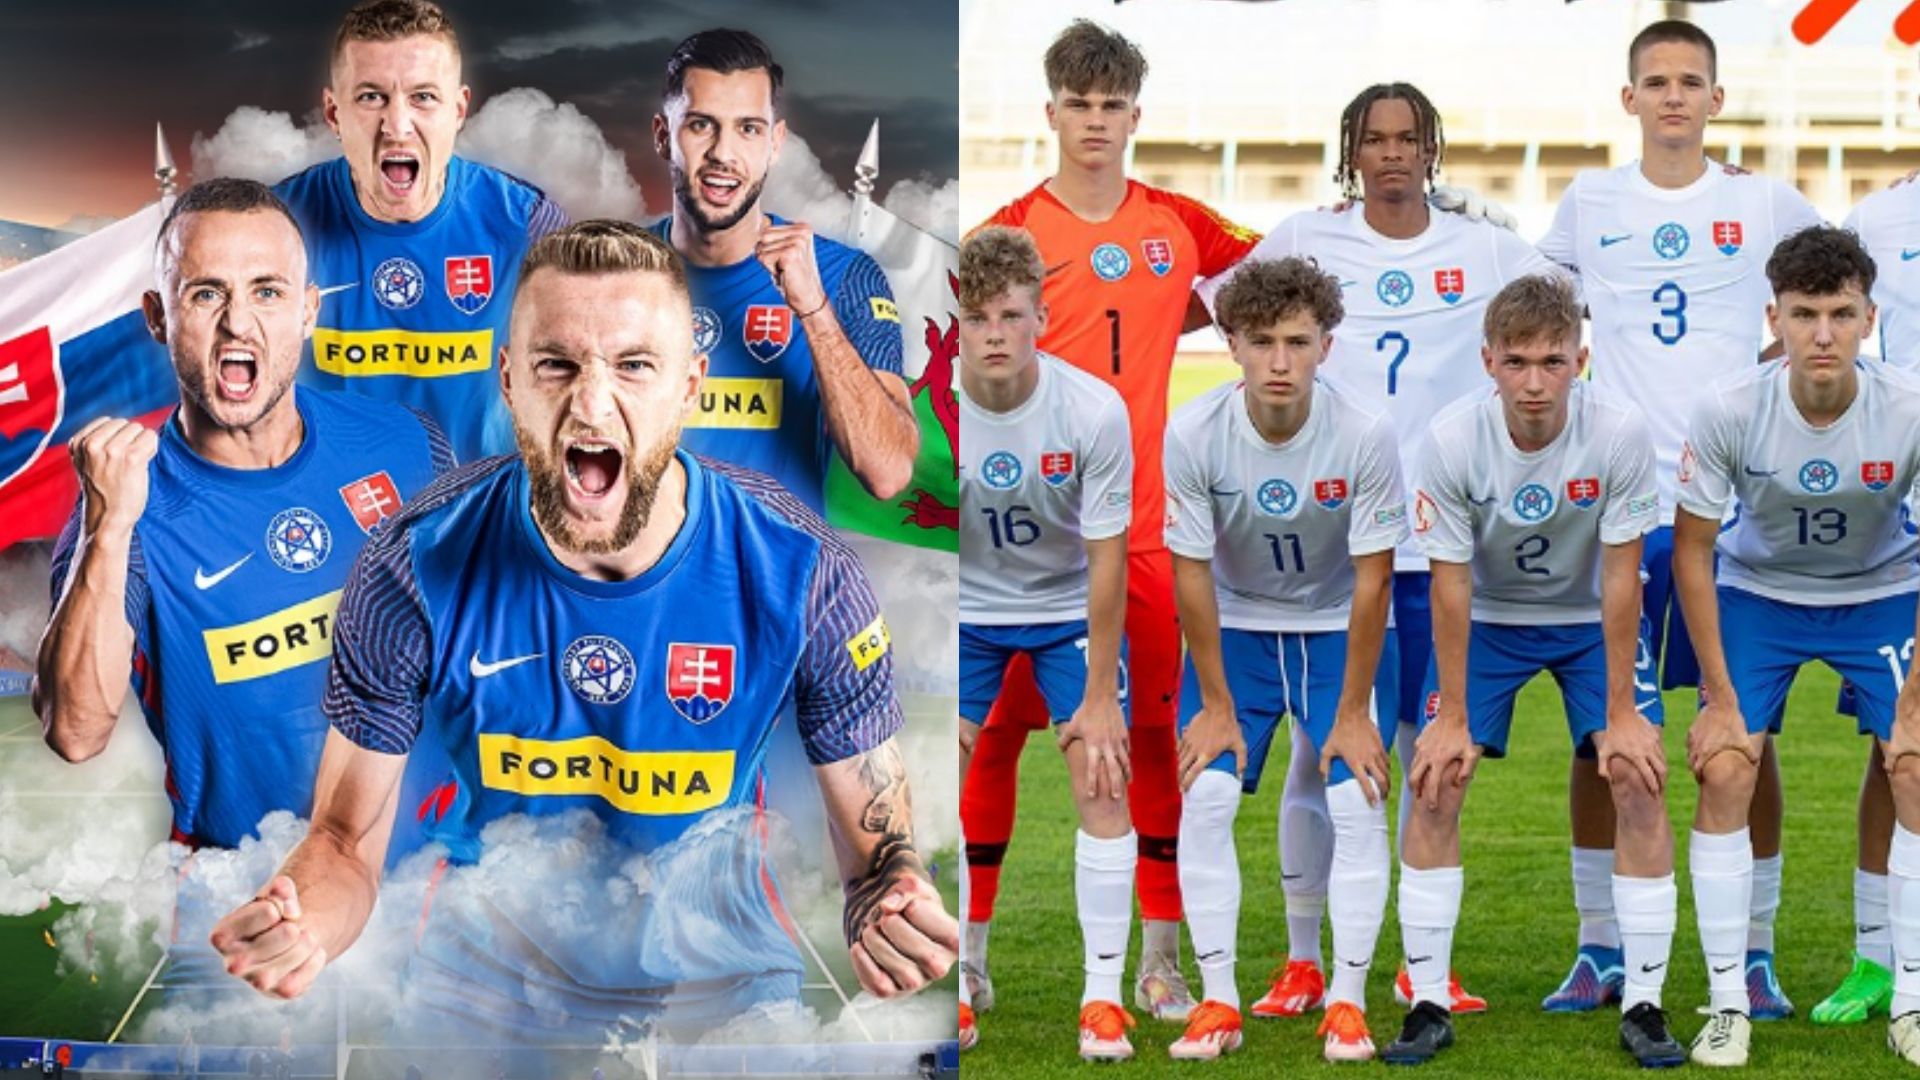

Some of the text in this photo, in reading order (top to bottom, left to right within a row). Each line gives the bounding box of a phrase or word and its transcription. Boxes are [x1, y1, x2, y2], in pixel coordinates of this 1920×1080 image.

[1653, 282, 1687, 345] 3
[326, 343, 478, 364] FORTUNA
[1106, 310, 1120, 376] 1
[1377, 331, 1409, 395] 7
[981, 505, 1042, 549] 16
[1791, 507, 1847, 545] 13
[1263, 534, 1305, 573] 11
[1515, 534, 1550, 576] 2
[225, 613, 329, 666] FORT
[500, 752, 711, 796] FORTUNA
